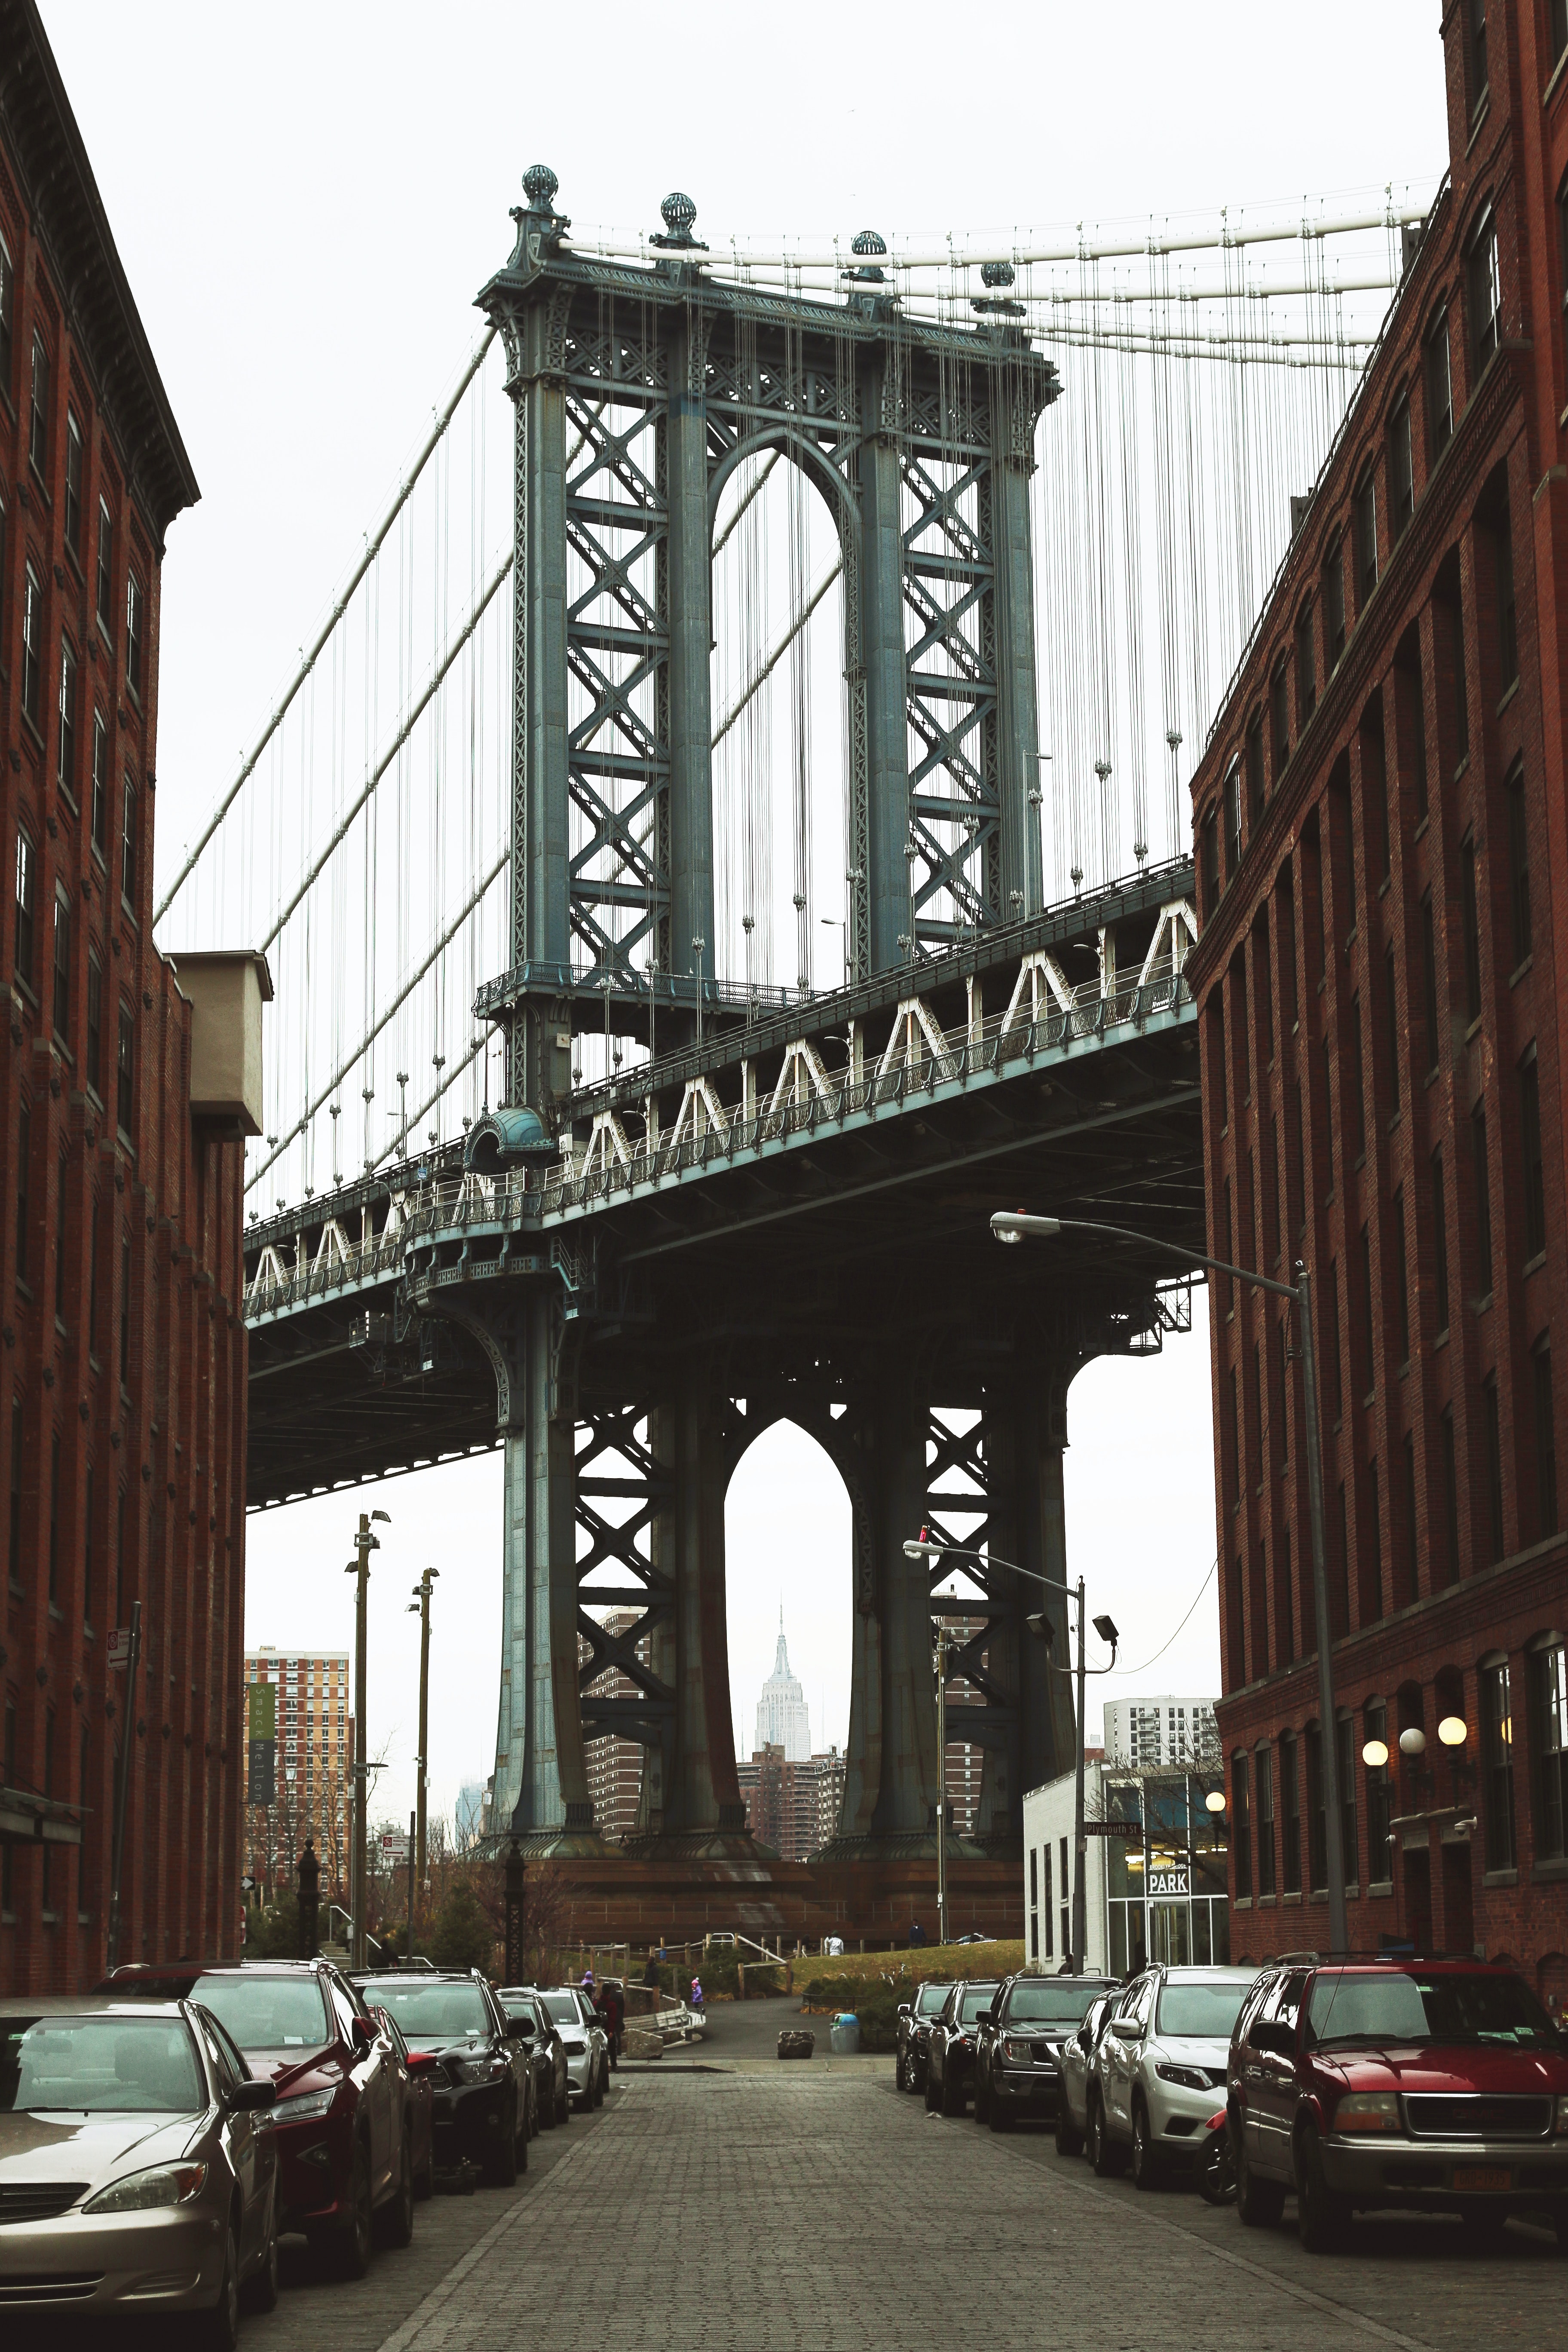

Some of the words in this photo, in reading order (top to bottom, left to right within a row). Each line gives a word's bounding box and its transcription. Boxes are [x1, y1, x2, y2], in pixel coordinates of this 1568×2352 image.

[255, 1689, 265, 1736] Smack
[254, 1744, 264, 1800] Mellon
[1088, 1825, 1127, 1835] Plymouth
[1129, 1825, 1137, 1834] St
[1149, 1873, 1187, 1892] PARK
[1452, 2108, 1507, 2119] GMC
